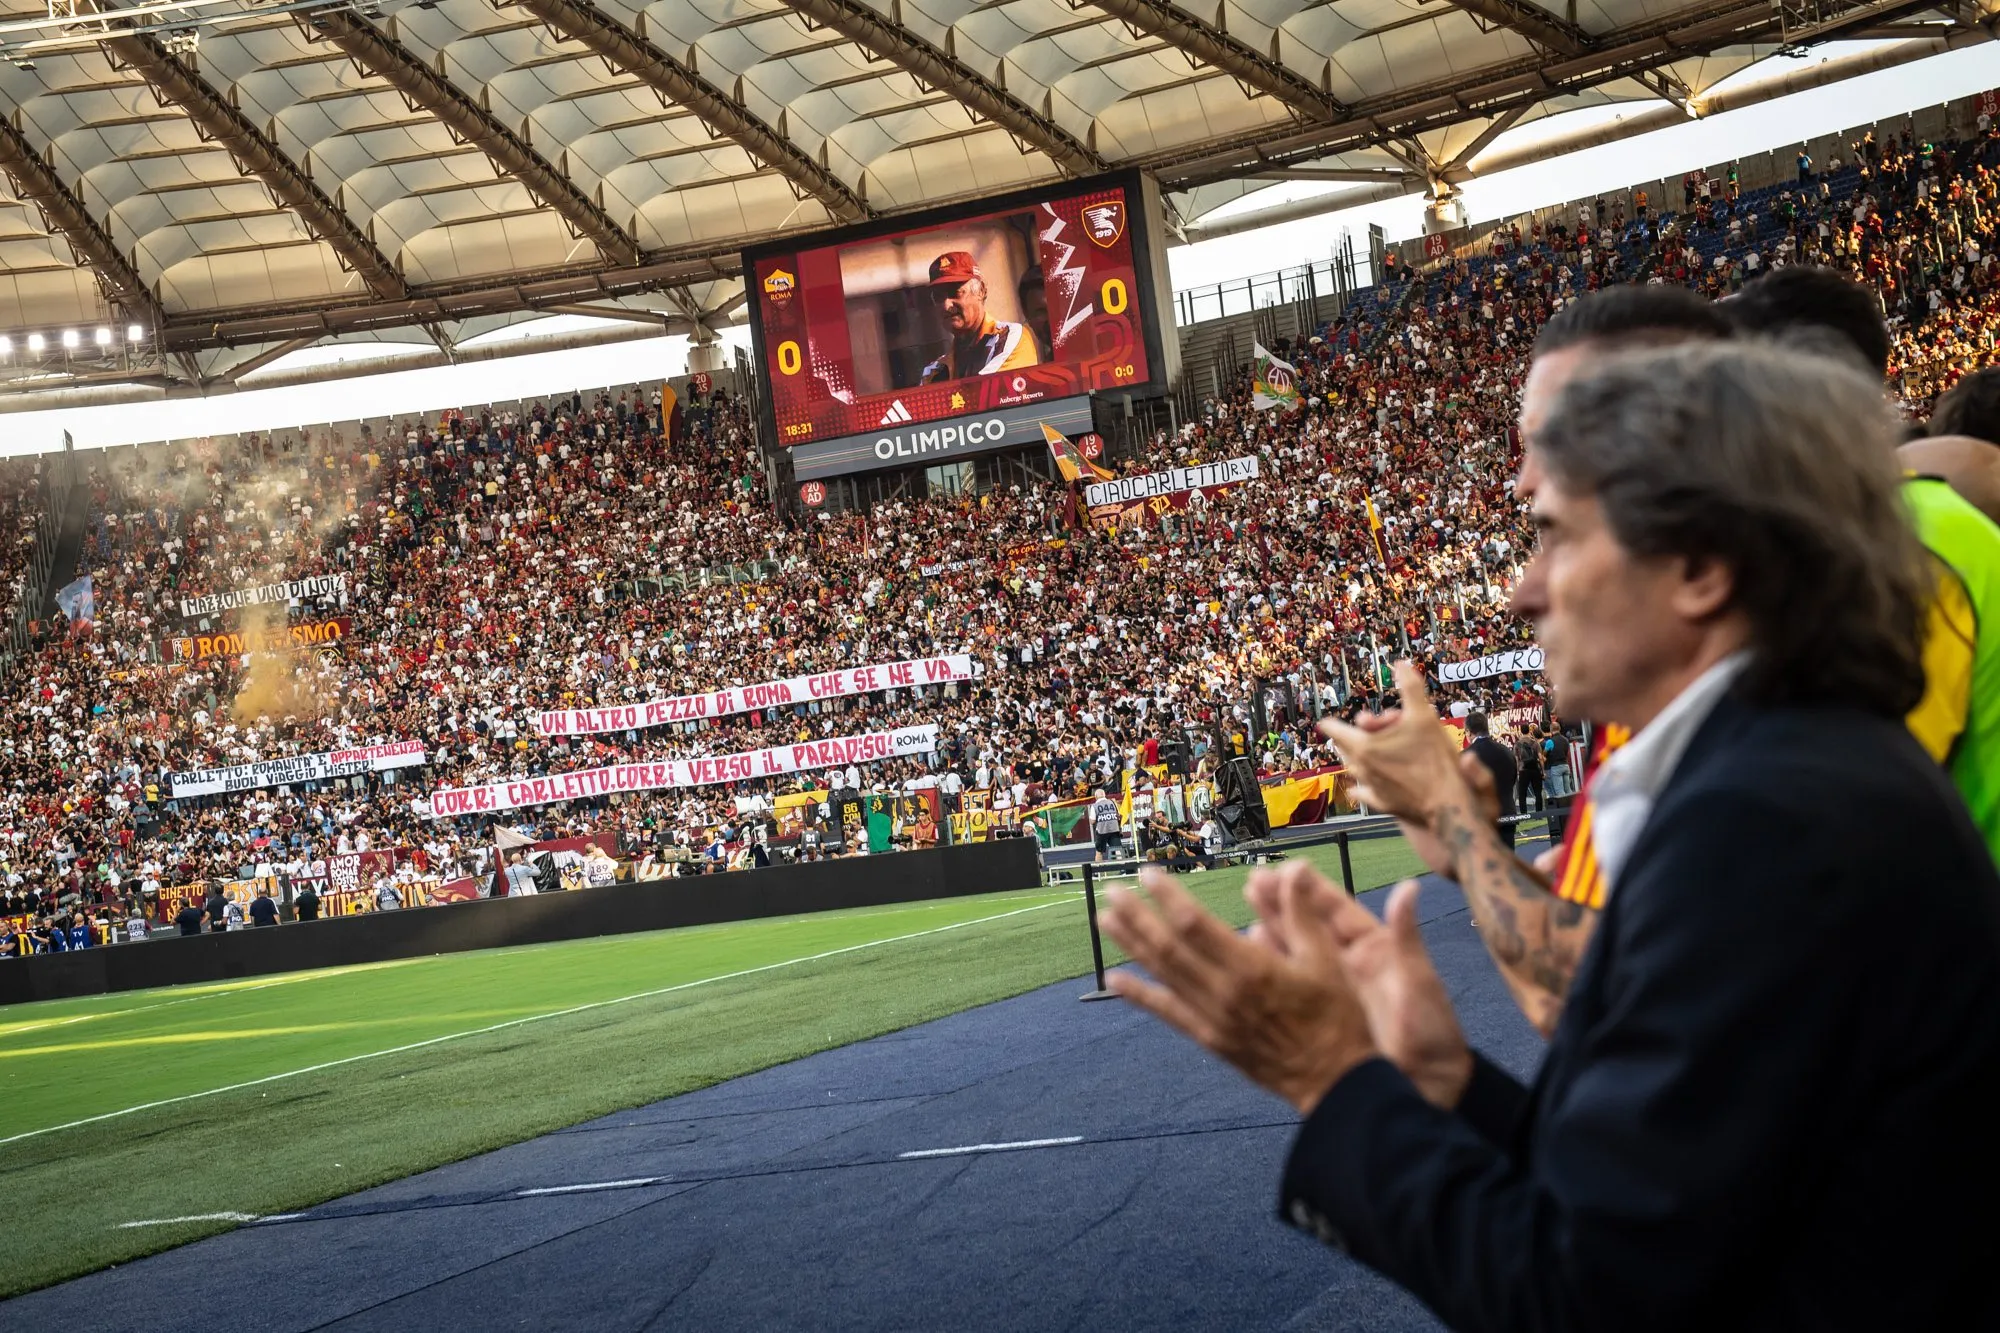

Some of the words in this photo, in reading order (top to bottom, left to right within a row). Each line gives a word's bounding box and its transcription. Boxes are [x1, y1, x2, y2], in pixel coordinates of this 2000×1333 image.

[1982, 91, 1995, 104] 18
[1095, 229, 1112, 238] 1919
[1430, 234, 1442, 245] 19
[1430, 244, 1445, 257] AD
[770, 291, 792, 300] ROMA
[1101, 278, 1128, 315] 0
[777, 340, 801, 376] 0
[1115, 364, 1134, 377] 0:0
[695, 374, 707, 384] 20
[1022, 391, 1044, 400] Resorts
[785, 422, 812, 436] 18:31
[874, 418, 1006, 460] OLIMPICO
[1084, 434, 1096, 445] 19
[1085, 445, 1098, 457] AS
[807, 481, 819, 492] 20
[807, 491, 822, 504] AD
[186, 590, 252, 615] MAZZONE
[256, 584, 286, 601] UNO
[197, 622, 341, 658] ROMAISMO
[1443, 652, 1505, 680] CUORE
[1512, 649, 1543, 670] RO
[541, 711, 568, 734] UN
[576, 707, 636, 733] ALTRO
[646, 696, 707, 725] PEZZO
[743, 682, 792, 709] ROMA
[809, 672, 846, 698] CHE
[854, 668, 879, 692] SE
[888, 662, 913, 686] NE
[925, 659, 969, 681] VA...
[896, 732, 928, 747] ROMA
[318, 754, 327, 766] E
[330, 740, 424, 764] APPARTENENZA
[688, 756, 751, 784] VERSO
[224, 777, 259, 792] BUON
[843, 802, 858, 813] 66
[1097, 804, 1115, 814] 044
[1097, 812, 1118, 821] PHOTO
[330, 855, 361, 869] AMOR
[331, 866, 359, 880] ROMAE
[591, 864, 609, 874] 189
